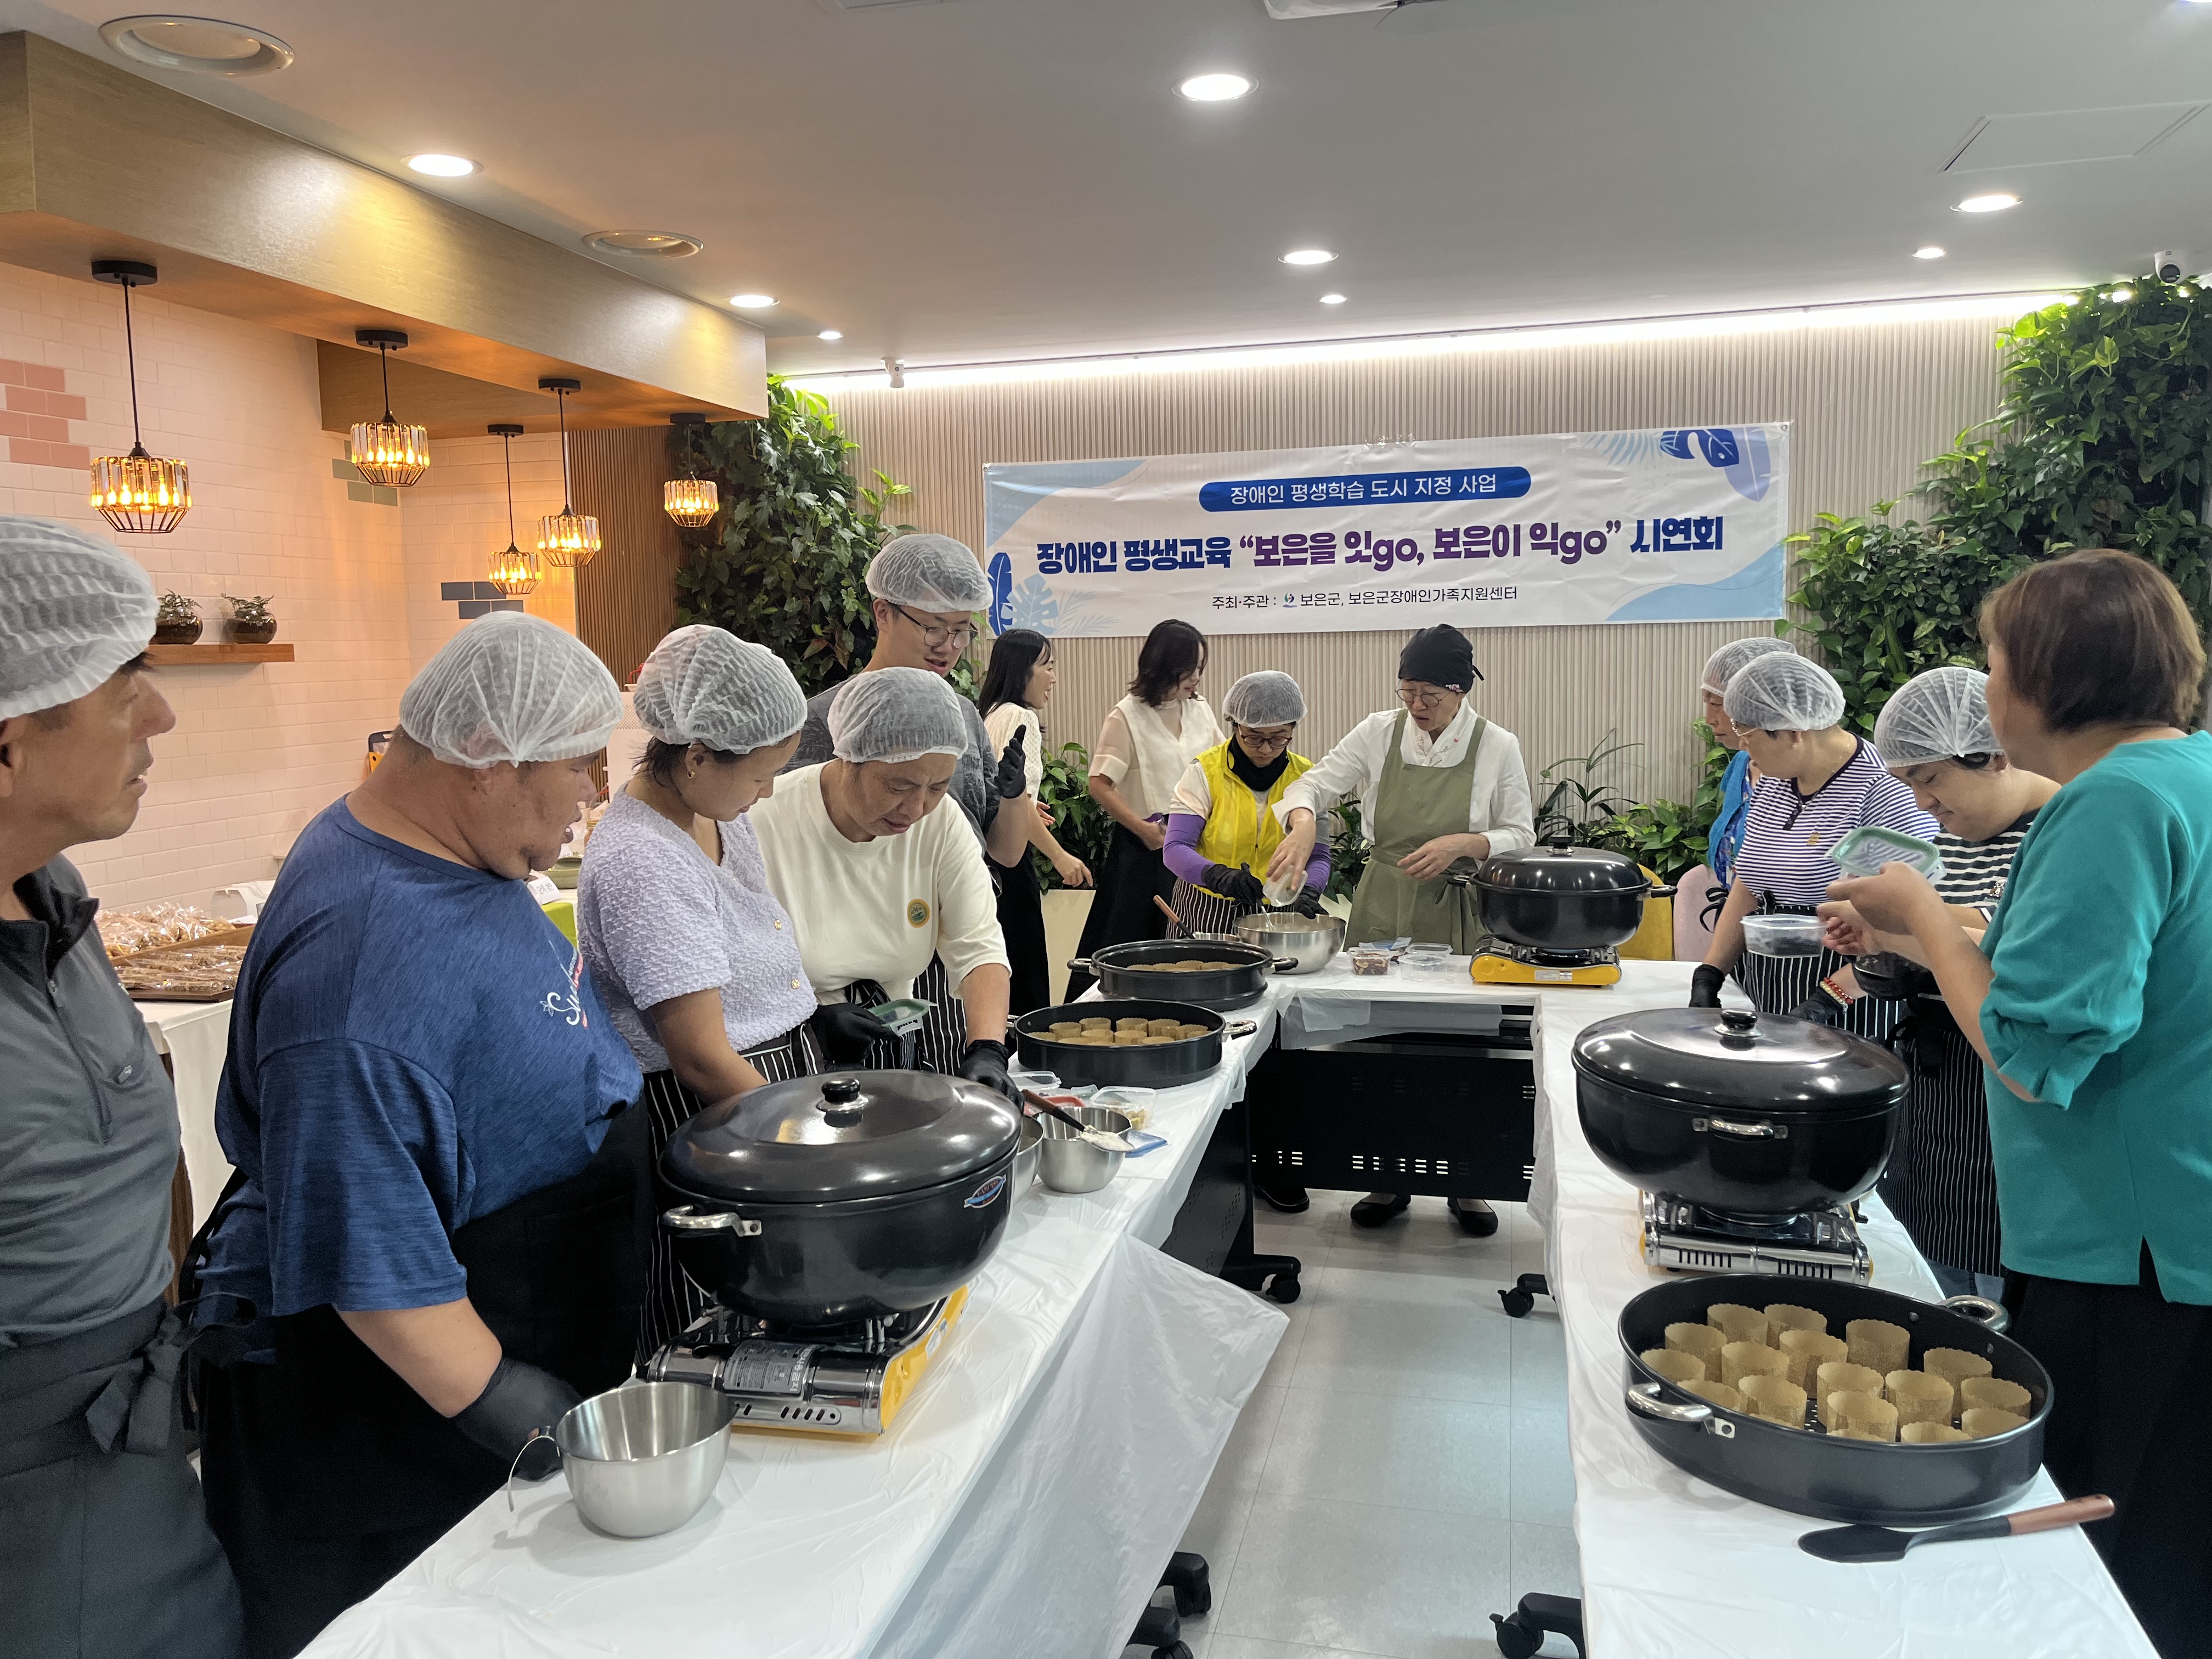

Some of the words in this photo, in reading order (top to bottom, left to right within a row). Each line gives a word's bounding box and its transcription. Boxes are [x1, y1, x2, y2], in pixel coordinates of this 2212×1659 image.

[1231, 486, 1284, 505] 장애인
[1291, 480, 1364, 502] 평생학습
[1371, 478, 1407, 498] 도시
[1414, 476, 1451, 495] 지정
[1459, 473, 1497, 494] 사업
[1036, 540, 1117, 574] 장애인
[1123, 537, 1232, 572] 평생교육
[1239, 532, 1336, 567] “보은을
[1344, 530, 1424, 572] 잇go,
[1433, 524, 1521, 560] 보은이
[1530, 520, 1622, 565] 익go”
[1629, 515, 1724, 554] 시연회
[1212, 595, 1269, 610] 주최·주관
[1300, 592, 1344, 607] 보은군,
[1348, 586, 1518, 606] 보은군장애인가족지원센터
